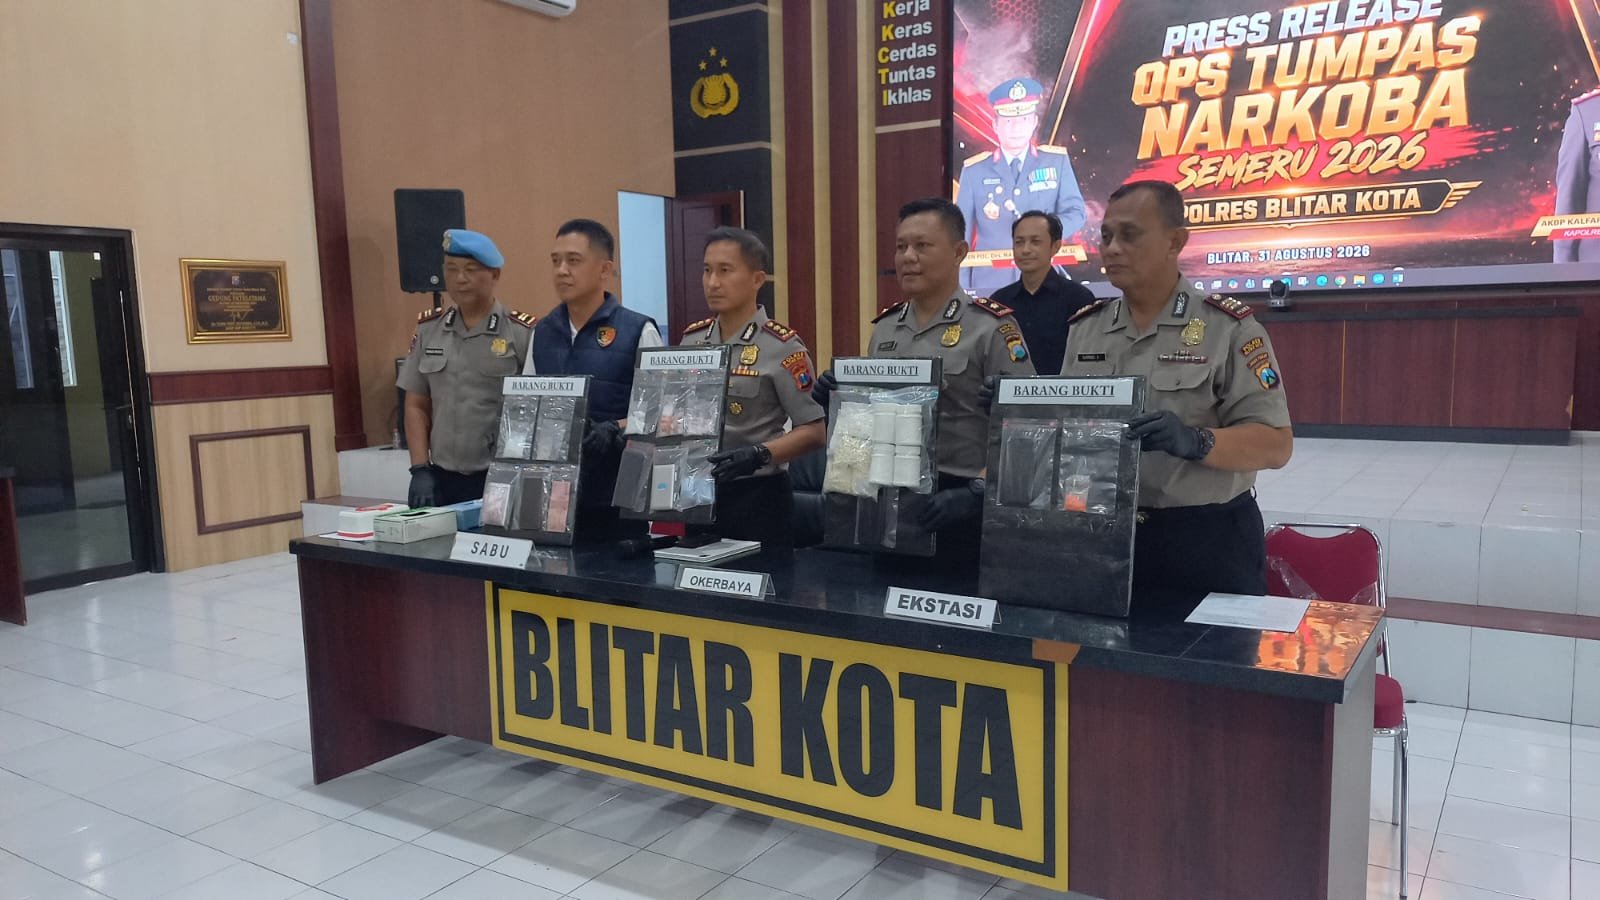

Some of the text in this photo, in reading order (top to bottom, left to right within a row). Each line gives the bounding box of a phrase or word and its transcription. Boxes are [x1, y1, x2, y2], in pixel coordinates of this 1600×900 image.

[883, 0, 930, 19] Kerja
[881, 21, 933, 41] Keras
[1162, 0, 1443, 57] PRESS RELEASE
[878, 42, 937, 64] Cerdas
[1132, 15, 1482, 106] OPS TUMPAS
[878, 65, 936, 85] Tuntas
[882, 87, 932, 106] Ikhlas
[1136, 67, 1470, 160] NARKOBA
[1175, 131, 1428, 192] SEMERU 2026
[1265, 193, 1347, 219] BLITAR
[1355, 187, 1421, 213] KOTA
[1207, 244, 1370, 265] BLITAR, 31 AGUSTUS 2026
[650, 354, 714, 365] BARANG BUKTI
[843, 365, 919, 376] BARANG BUKTI
[512, 381, 574, 391] BARANG BUKTI
[1013, 385, 1114, 397] BARANG BUKTI
[471, 541, 510, 559] SABU
[689, 575, 752, 593] OKERBAYA
[897, 594, 982, 620] EKSTASI
[511, 610, 1023, 830] BLITAR KOTA
